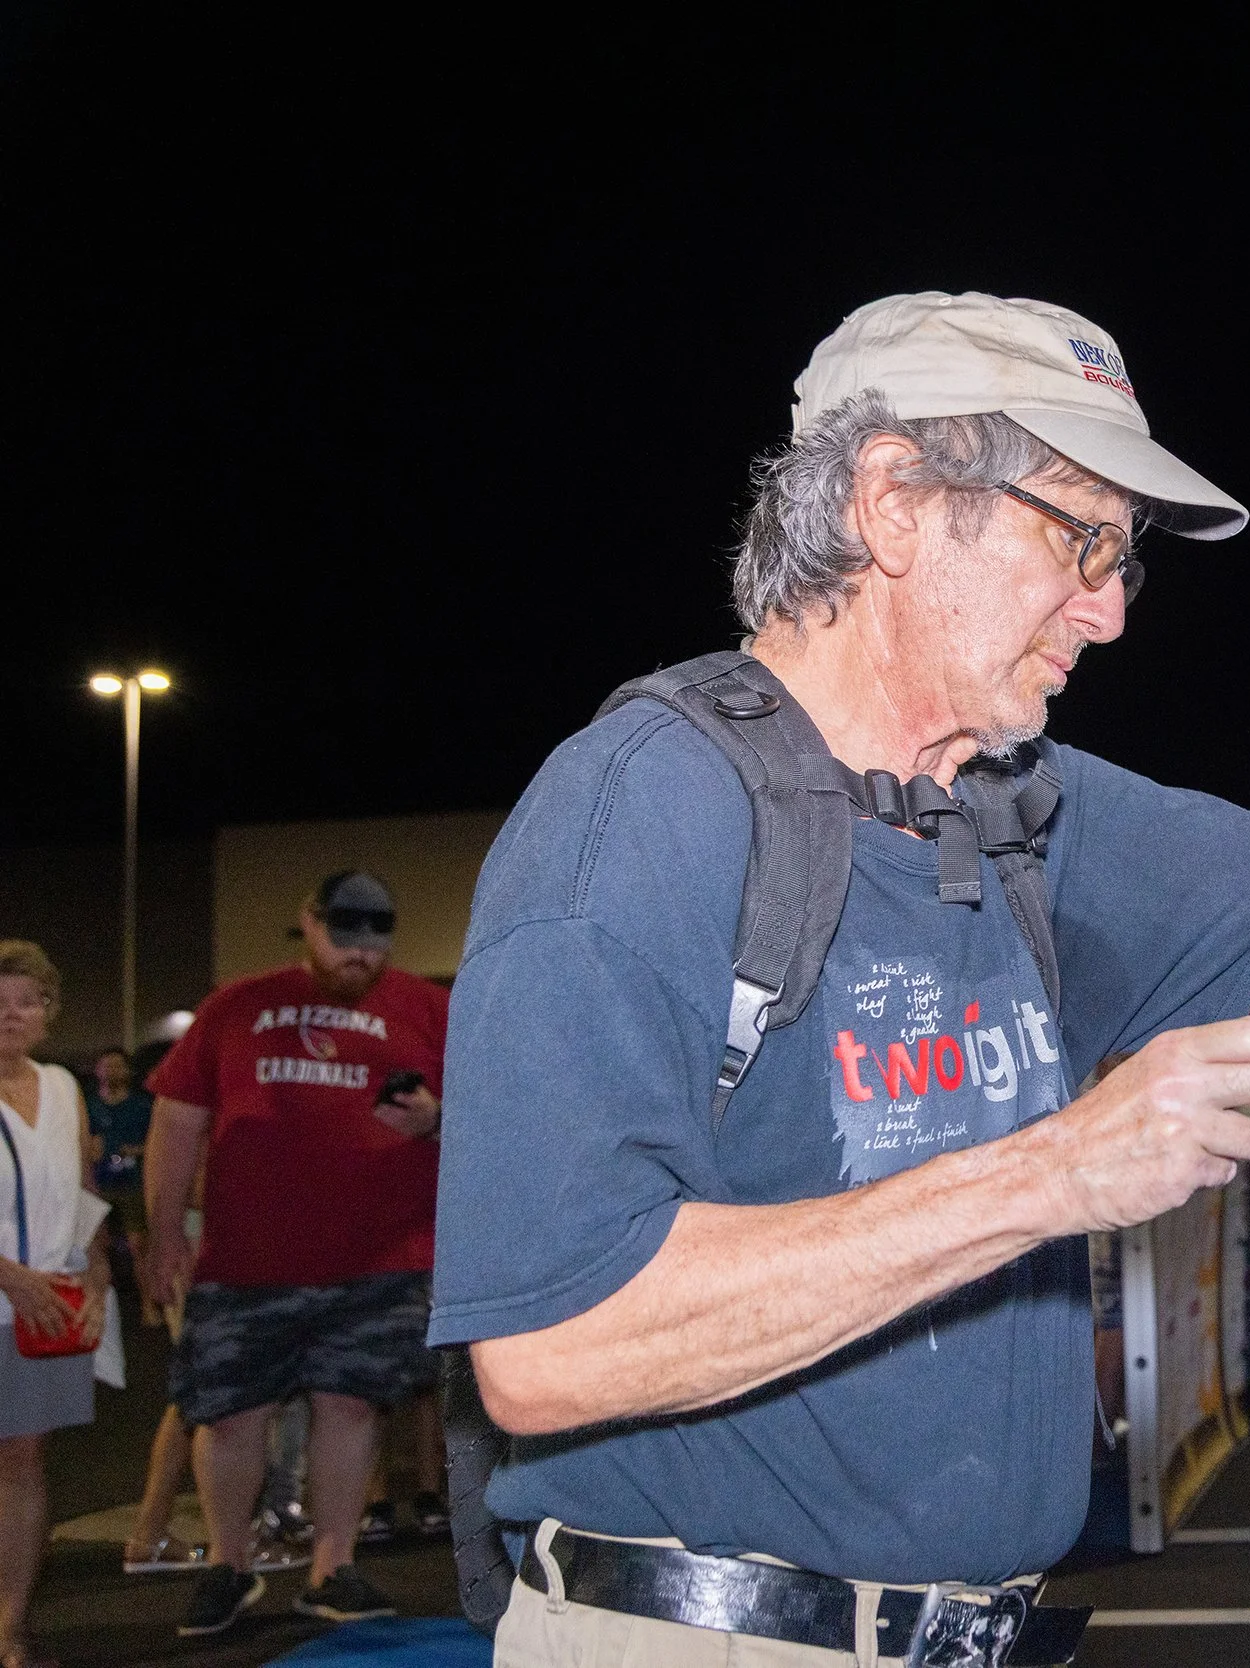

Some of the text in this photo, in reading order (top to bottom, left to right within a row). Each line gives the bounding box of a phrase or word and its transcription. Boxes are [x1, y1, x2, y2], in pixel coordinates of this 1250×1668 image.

[855, 975, 891, 994] sweat
[856, 995, 886, 1018] play
[913, 987, 943, 1011] fight
[252, 1004, 388, 1041] ARIZONA
[256, 1056, 369, 1089] CARDINALS
[885, 1115, 917, 1131] break
[873, 1134, 900, 1149] link
